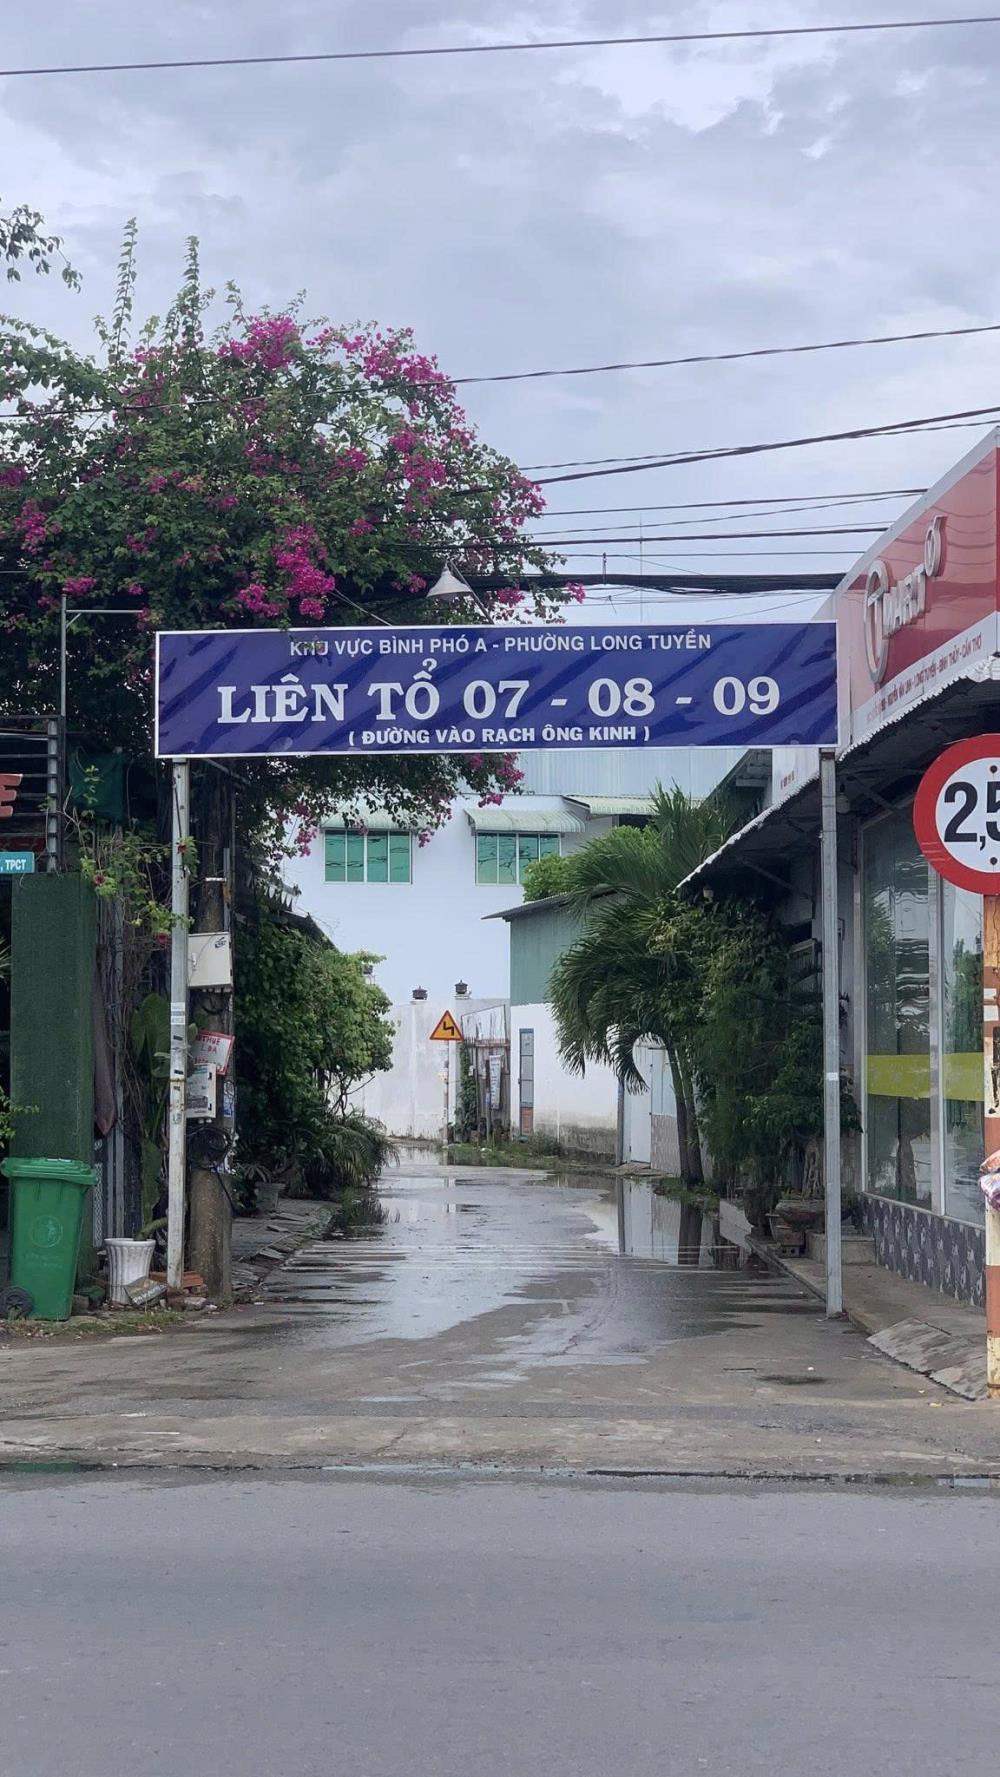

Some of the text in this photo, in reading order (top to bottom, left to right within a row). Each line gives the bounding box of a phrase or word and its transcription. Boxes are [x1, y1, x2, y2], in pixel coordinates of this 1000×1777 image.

[335, 638, 373, 657] VỰC
[380, 635, 424, 654] BÌNH
[430, 634, 469, 653] PHÓ
[475, 638, 488, 653] A
[505, 633, 585, 652] PHƯỜNG
[591, 635, 642, 651] LONG
[648, 628, 711, 650] TUYỀN
[217, 658, 780, 723] LIÊN TỔ 07 - 08 - 09
[362, 726, 430, 745] ĐƯỜNG
[435, 726, 476, 744] VÀO
[482, 727, 535, 745] RẠCH
[541, 724, 583, 742] ÔNG
[589, 726, 636, 741] KINH
[5, 859, 27, 871] TPCT
